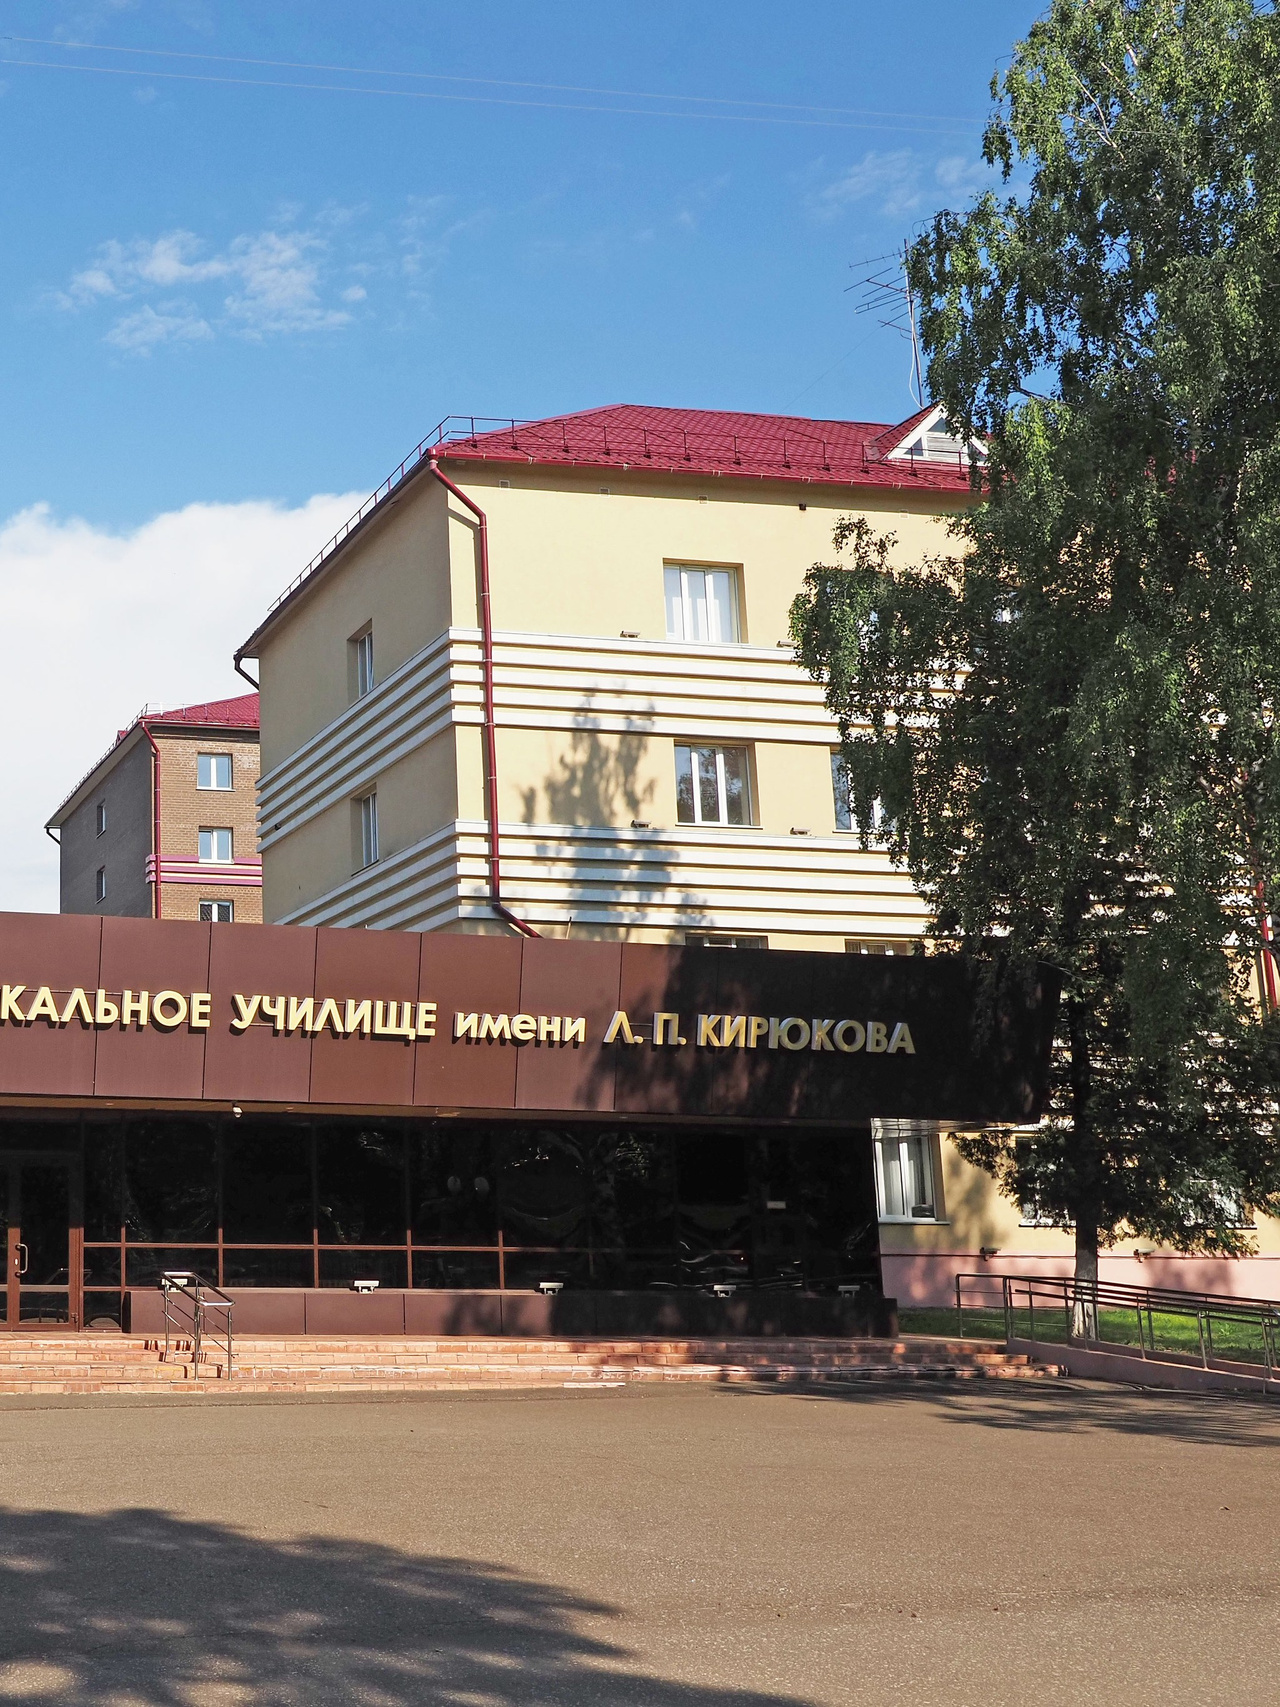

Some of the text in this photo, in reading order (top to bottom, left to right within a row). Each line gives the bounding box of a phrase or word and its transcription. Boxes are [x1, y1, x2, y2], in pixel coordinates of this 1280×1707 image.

[230, 993, 438, 1040] УЧИЛИЩЕ
[453, 1011, 586, 1043] имени
[603, 1009, 644, 1044] Л.
[653, 1011, 687, 1046] П.
[696, 1013, 916, 1055] КИРЮКОВА
